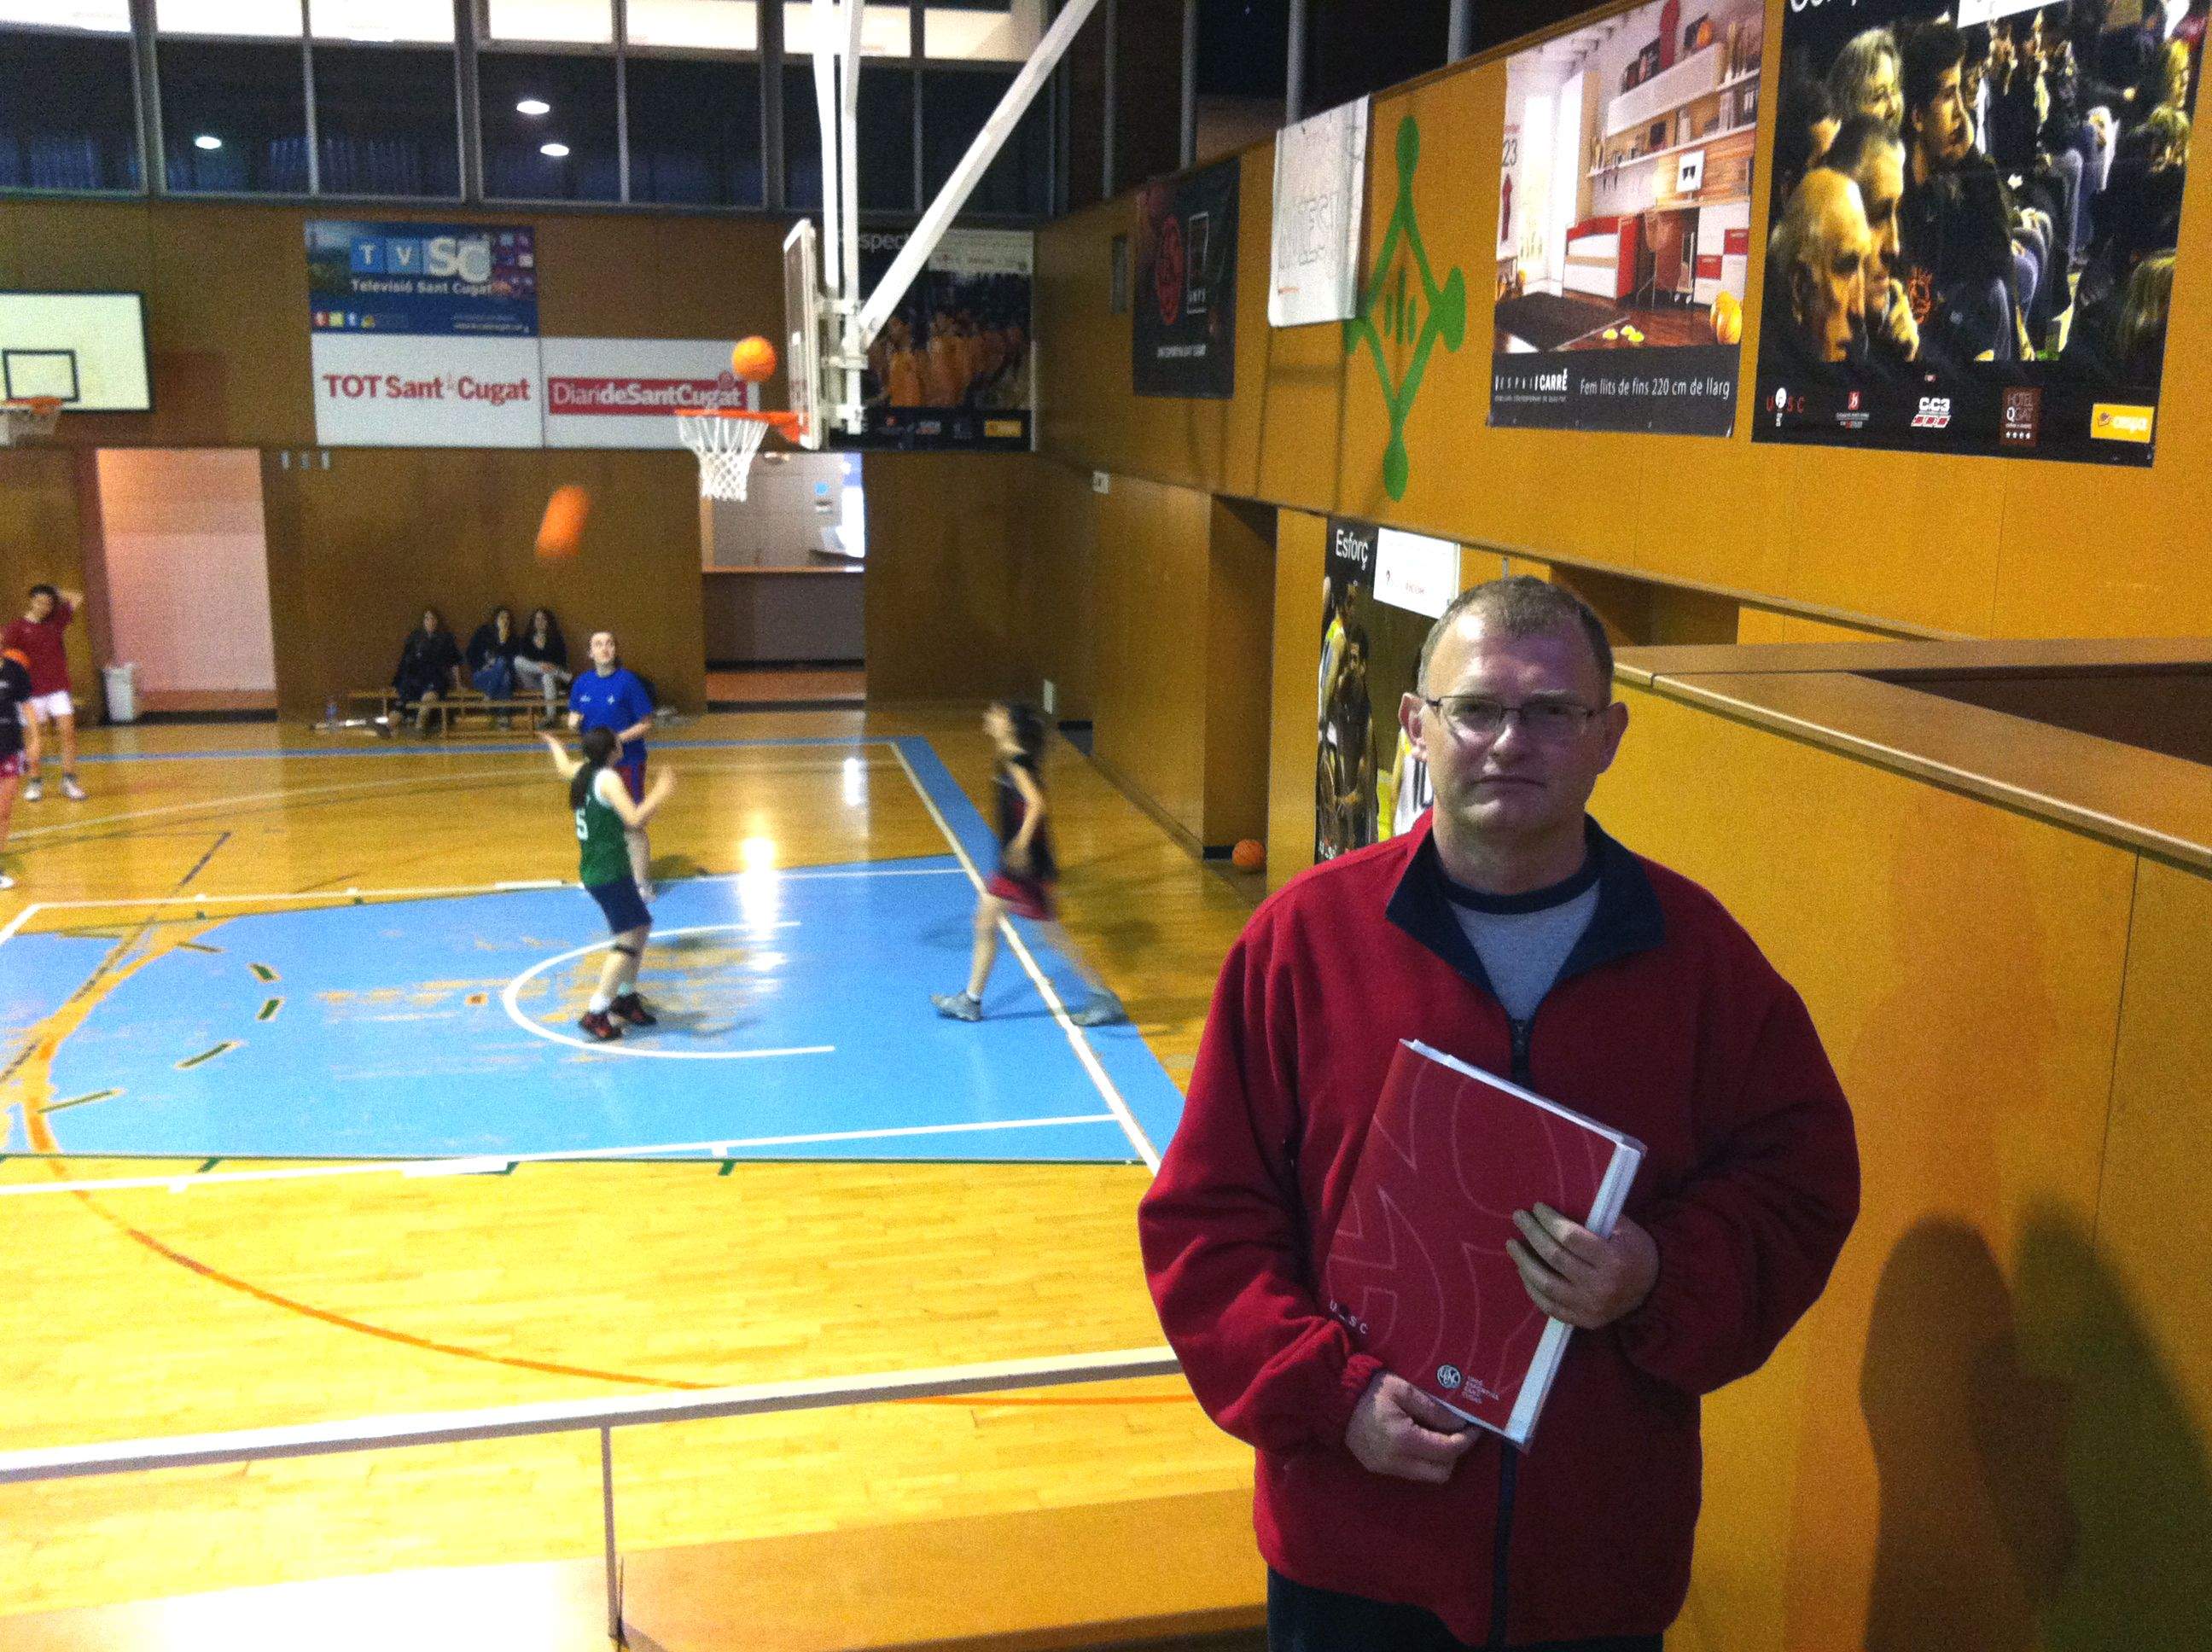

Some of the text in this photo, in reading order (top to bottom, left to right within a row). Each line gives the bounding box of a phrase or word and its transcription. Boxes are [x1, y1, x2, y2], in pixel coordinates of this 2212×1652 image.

[418, 280, 448, 294] Sant
[452, 281, 492, 297] Cugat
[323, 374, 530, 406] TOT Sant Cugat
[1580, 377, 1730, 400] Fem llits de fins 220 cm de llarg
[1336, 528, 1368, 571] Esforç
